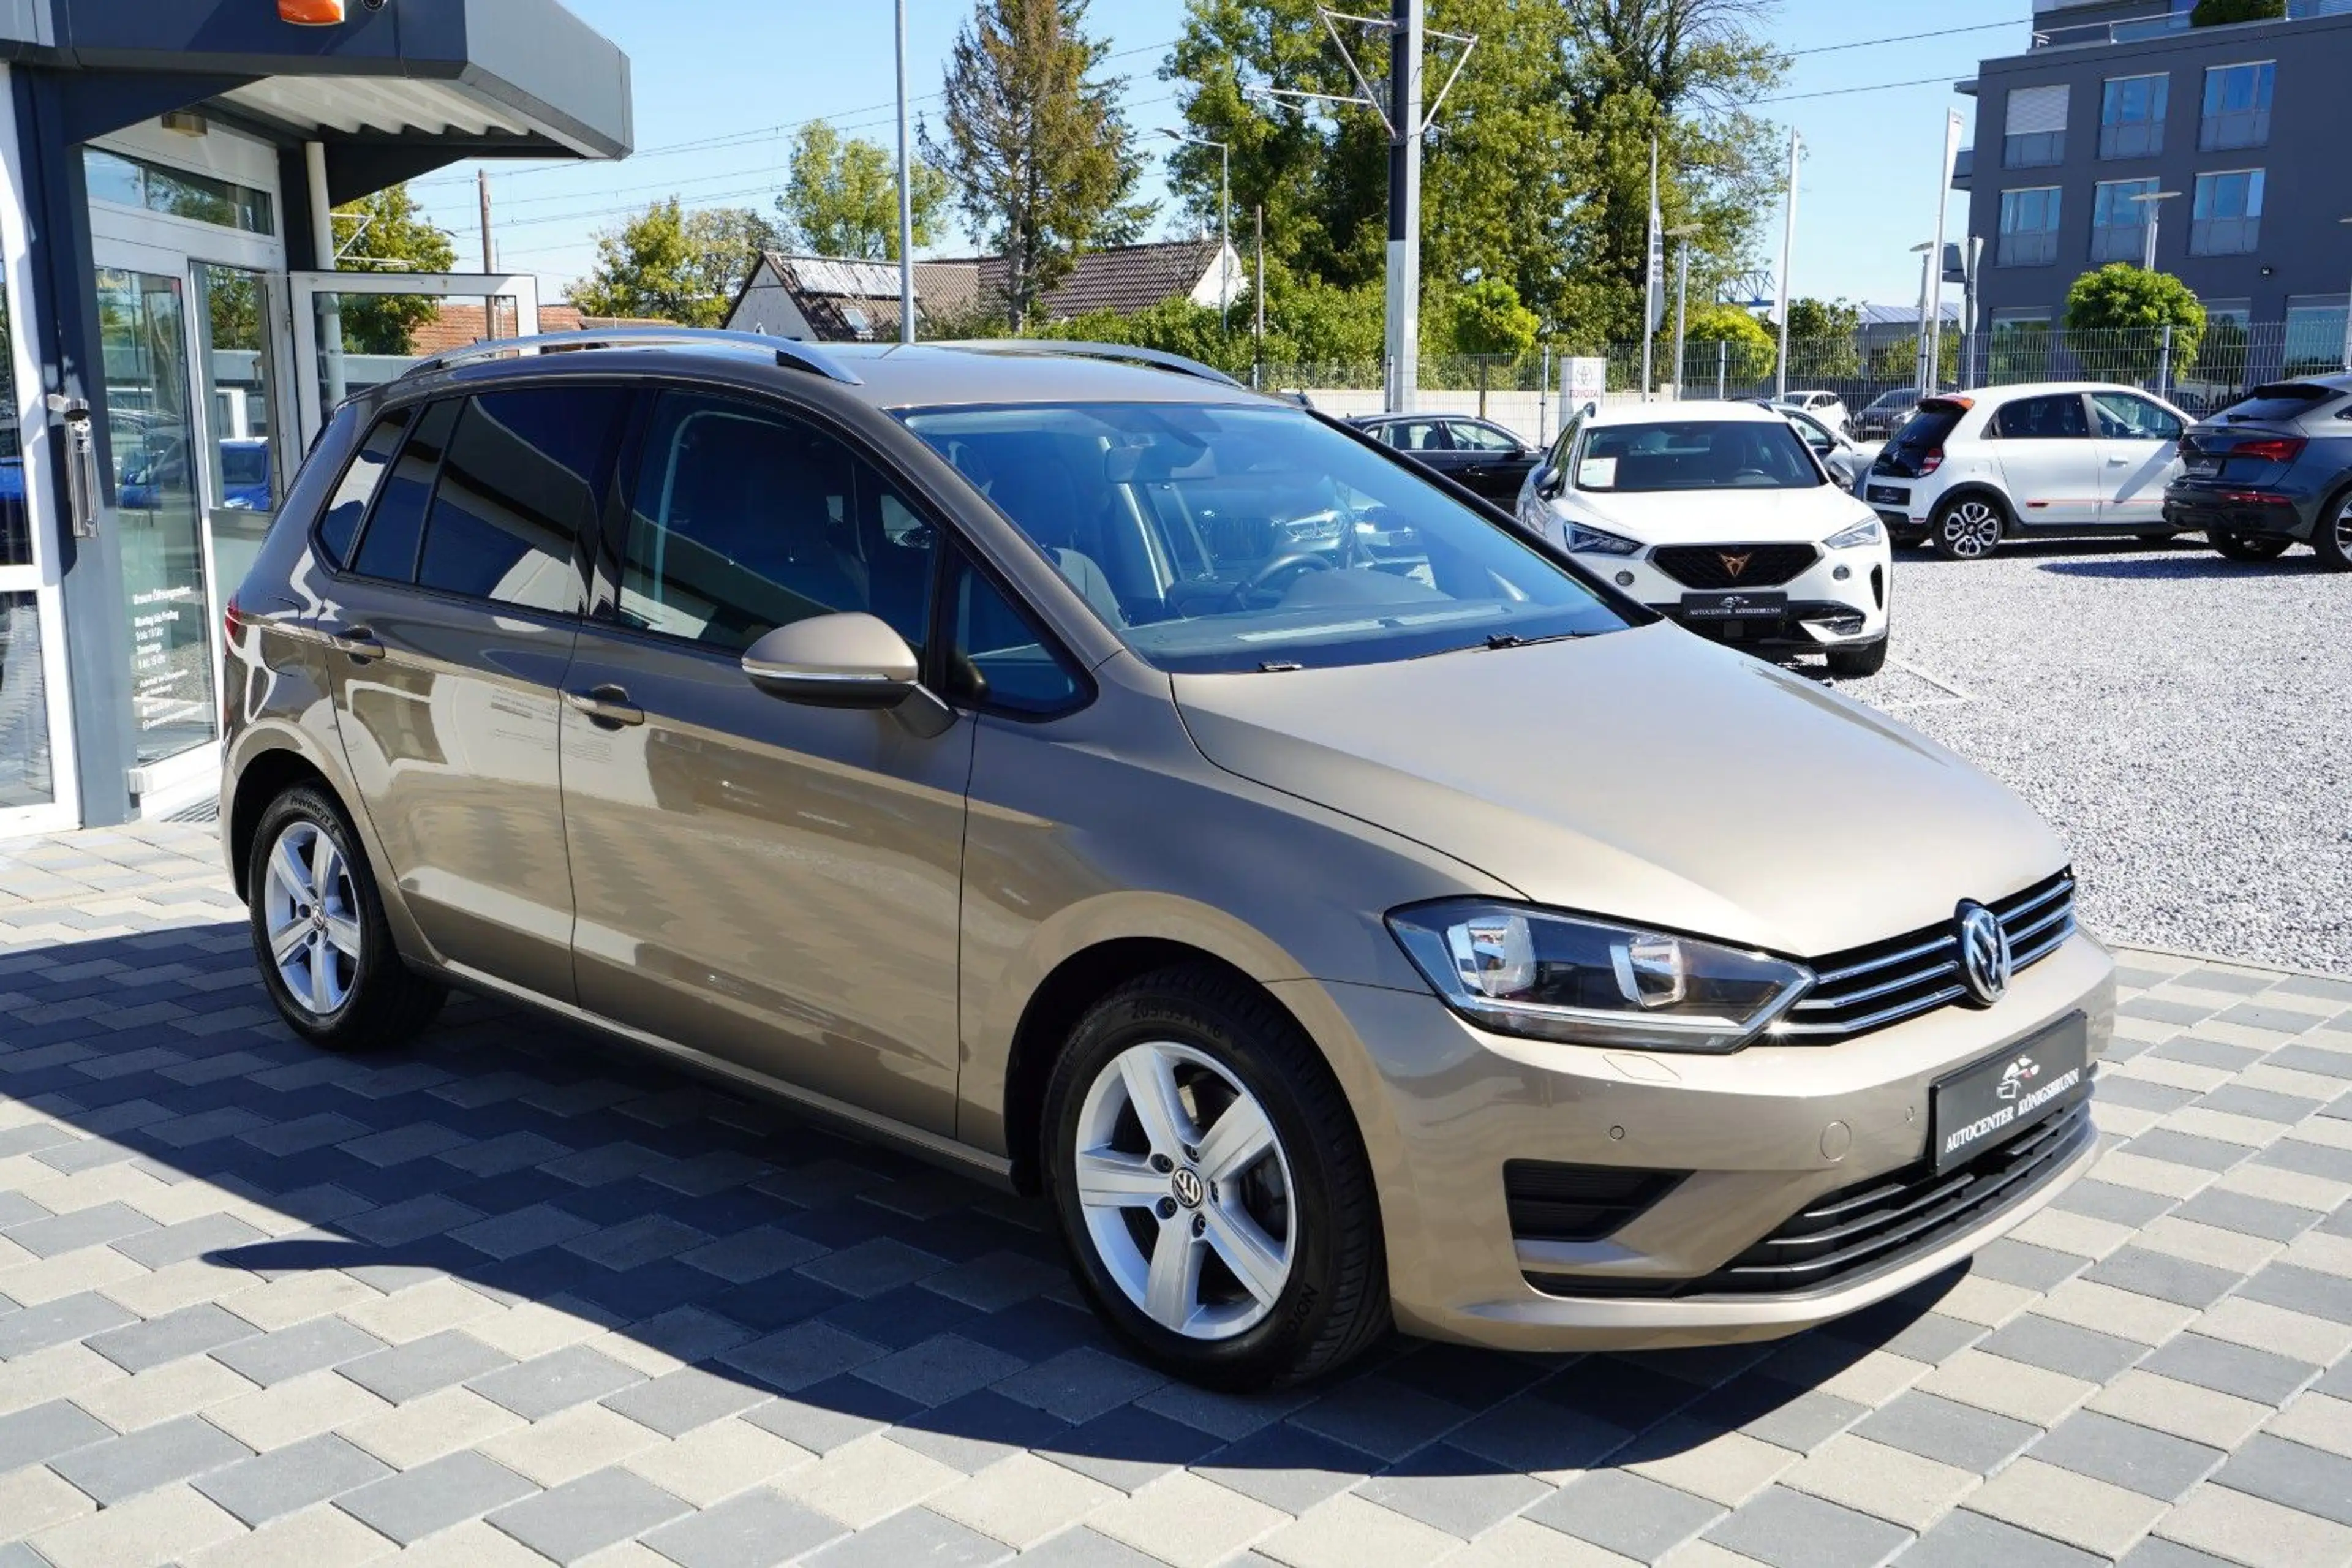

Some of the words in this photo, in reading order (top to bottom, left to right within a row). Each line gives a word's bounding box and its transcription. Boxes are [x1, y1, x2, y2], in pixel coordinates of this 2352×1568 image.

[1569, 389, 1598, 398] TOYOTA
[1945, 1106, 2015, 1153] AUTOCENTER
[2018, 1068, 2079, 1116] KÖNIGSBRUNN
